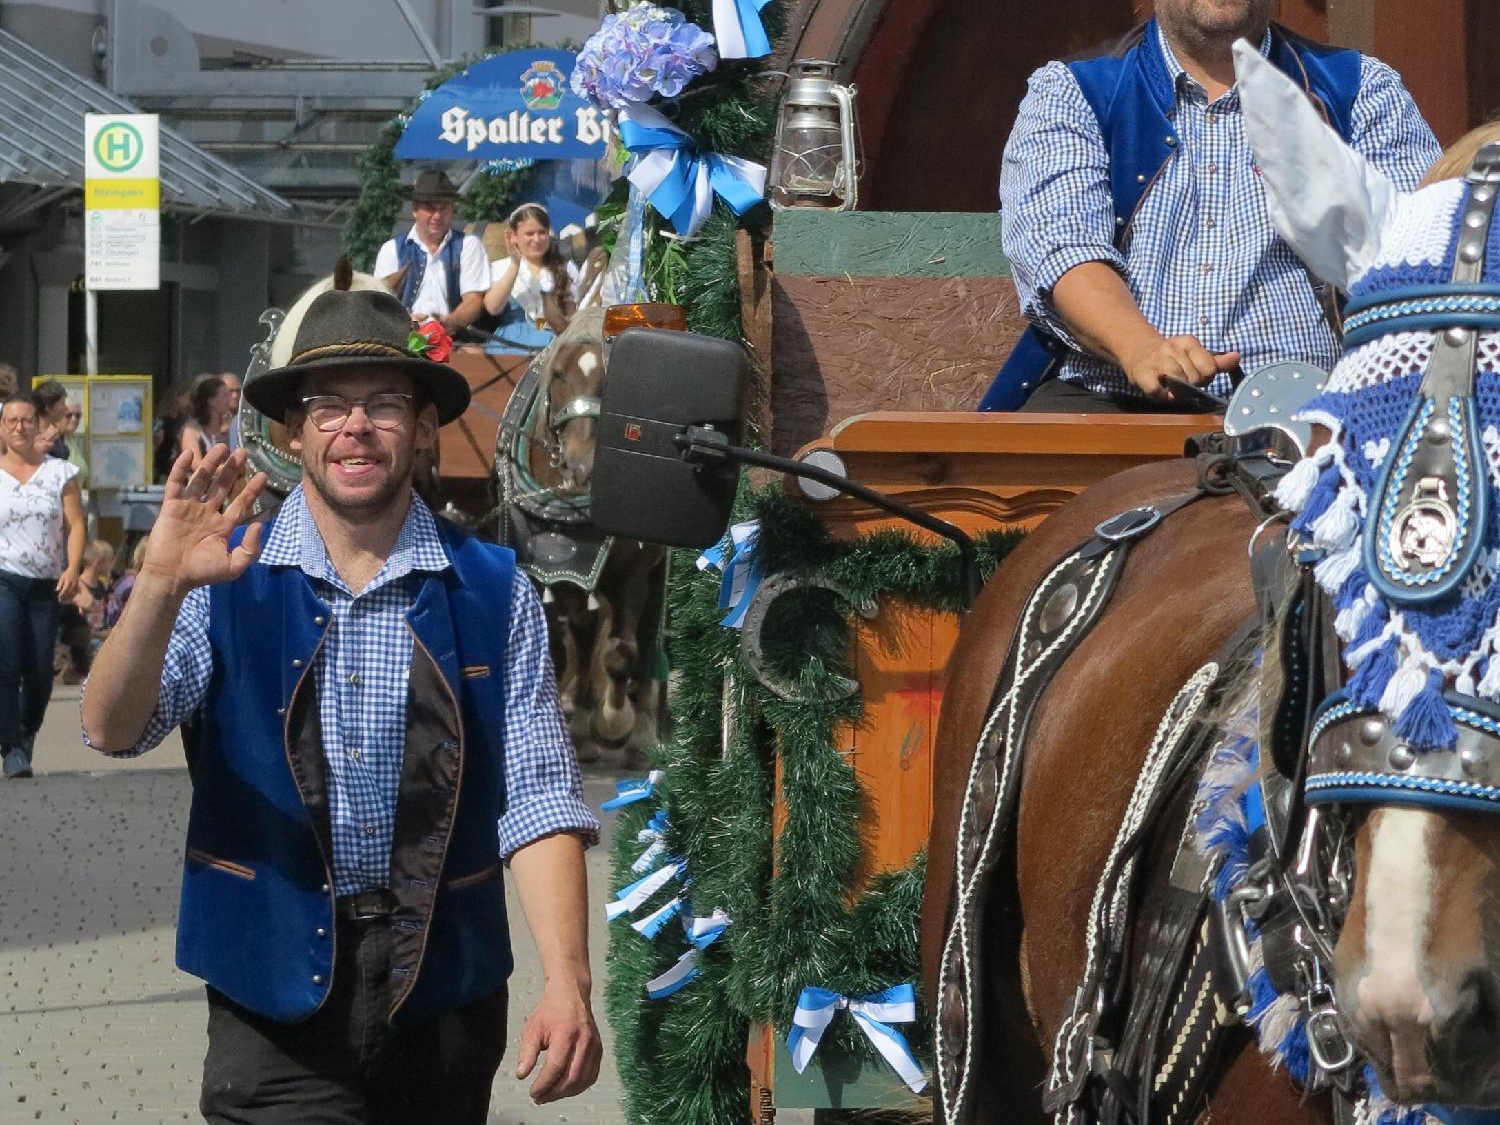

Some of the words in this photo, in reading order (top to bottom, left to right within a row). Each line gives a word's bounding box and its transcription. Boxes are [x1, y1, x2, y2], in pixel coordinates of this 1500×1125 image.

[106, 133, 131, 161] H
[438, 105, 564, 152] Spalter
[575, 106, 610, 145] Bi
